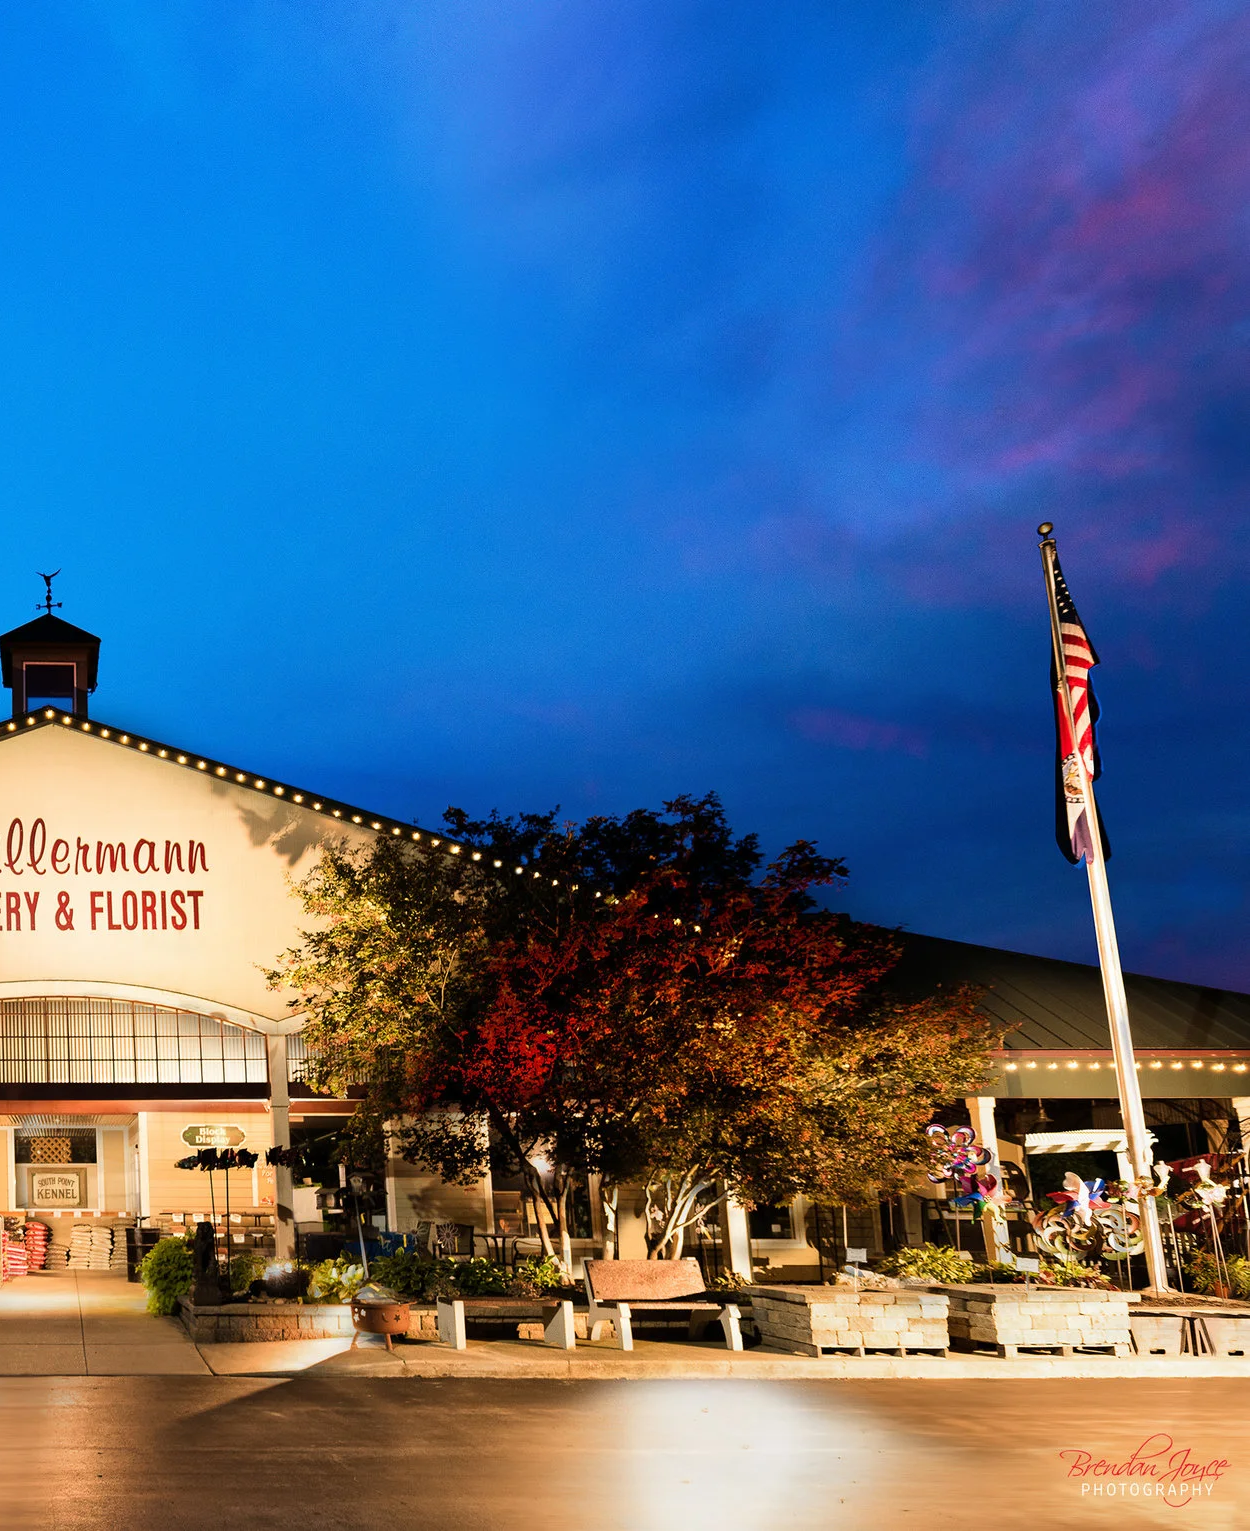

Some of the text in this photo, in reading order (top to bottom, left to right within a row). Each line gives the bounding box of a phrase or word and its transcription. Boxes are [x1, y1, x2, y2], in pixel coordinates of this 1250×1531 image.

[54, 890, 75, 932] &
[89, 889, 205, 931] FLORIST
[199, 1127, 227, 1136] Block
[195, 1135, 231, 1146] Display
[37, 1177, 75, 1188] SOUTH POINT
[37, 1188, 78, 1199] KENNEL
